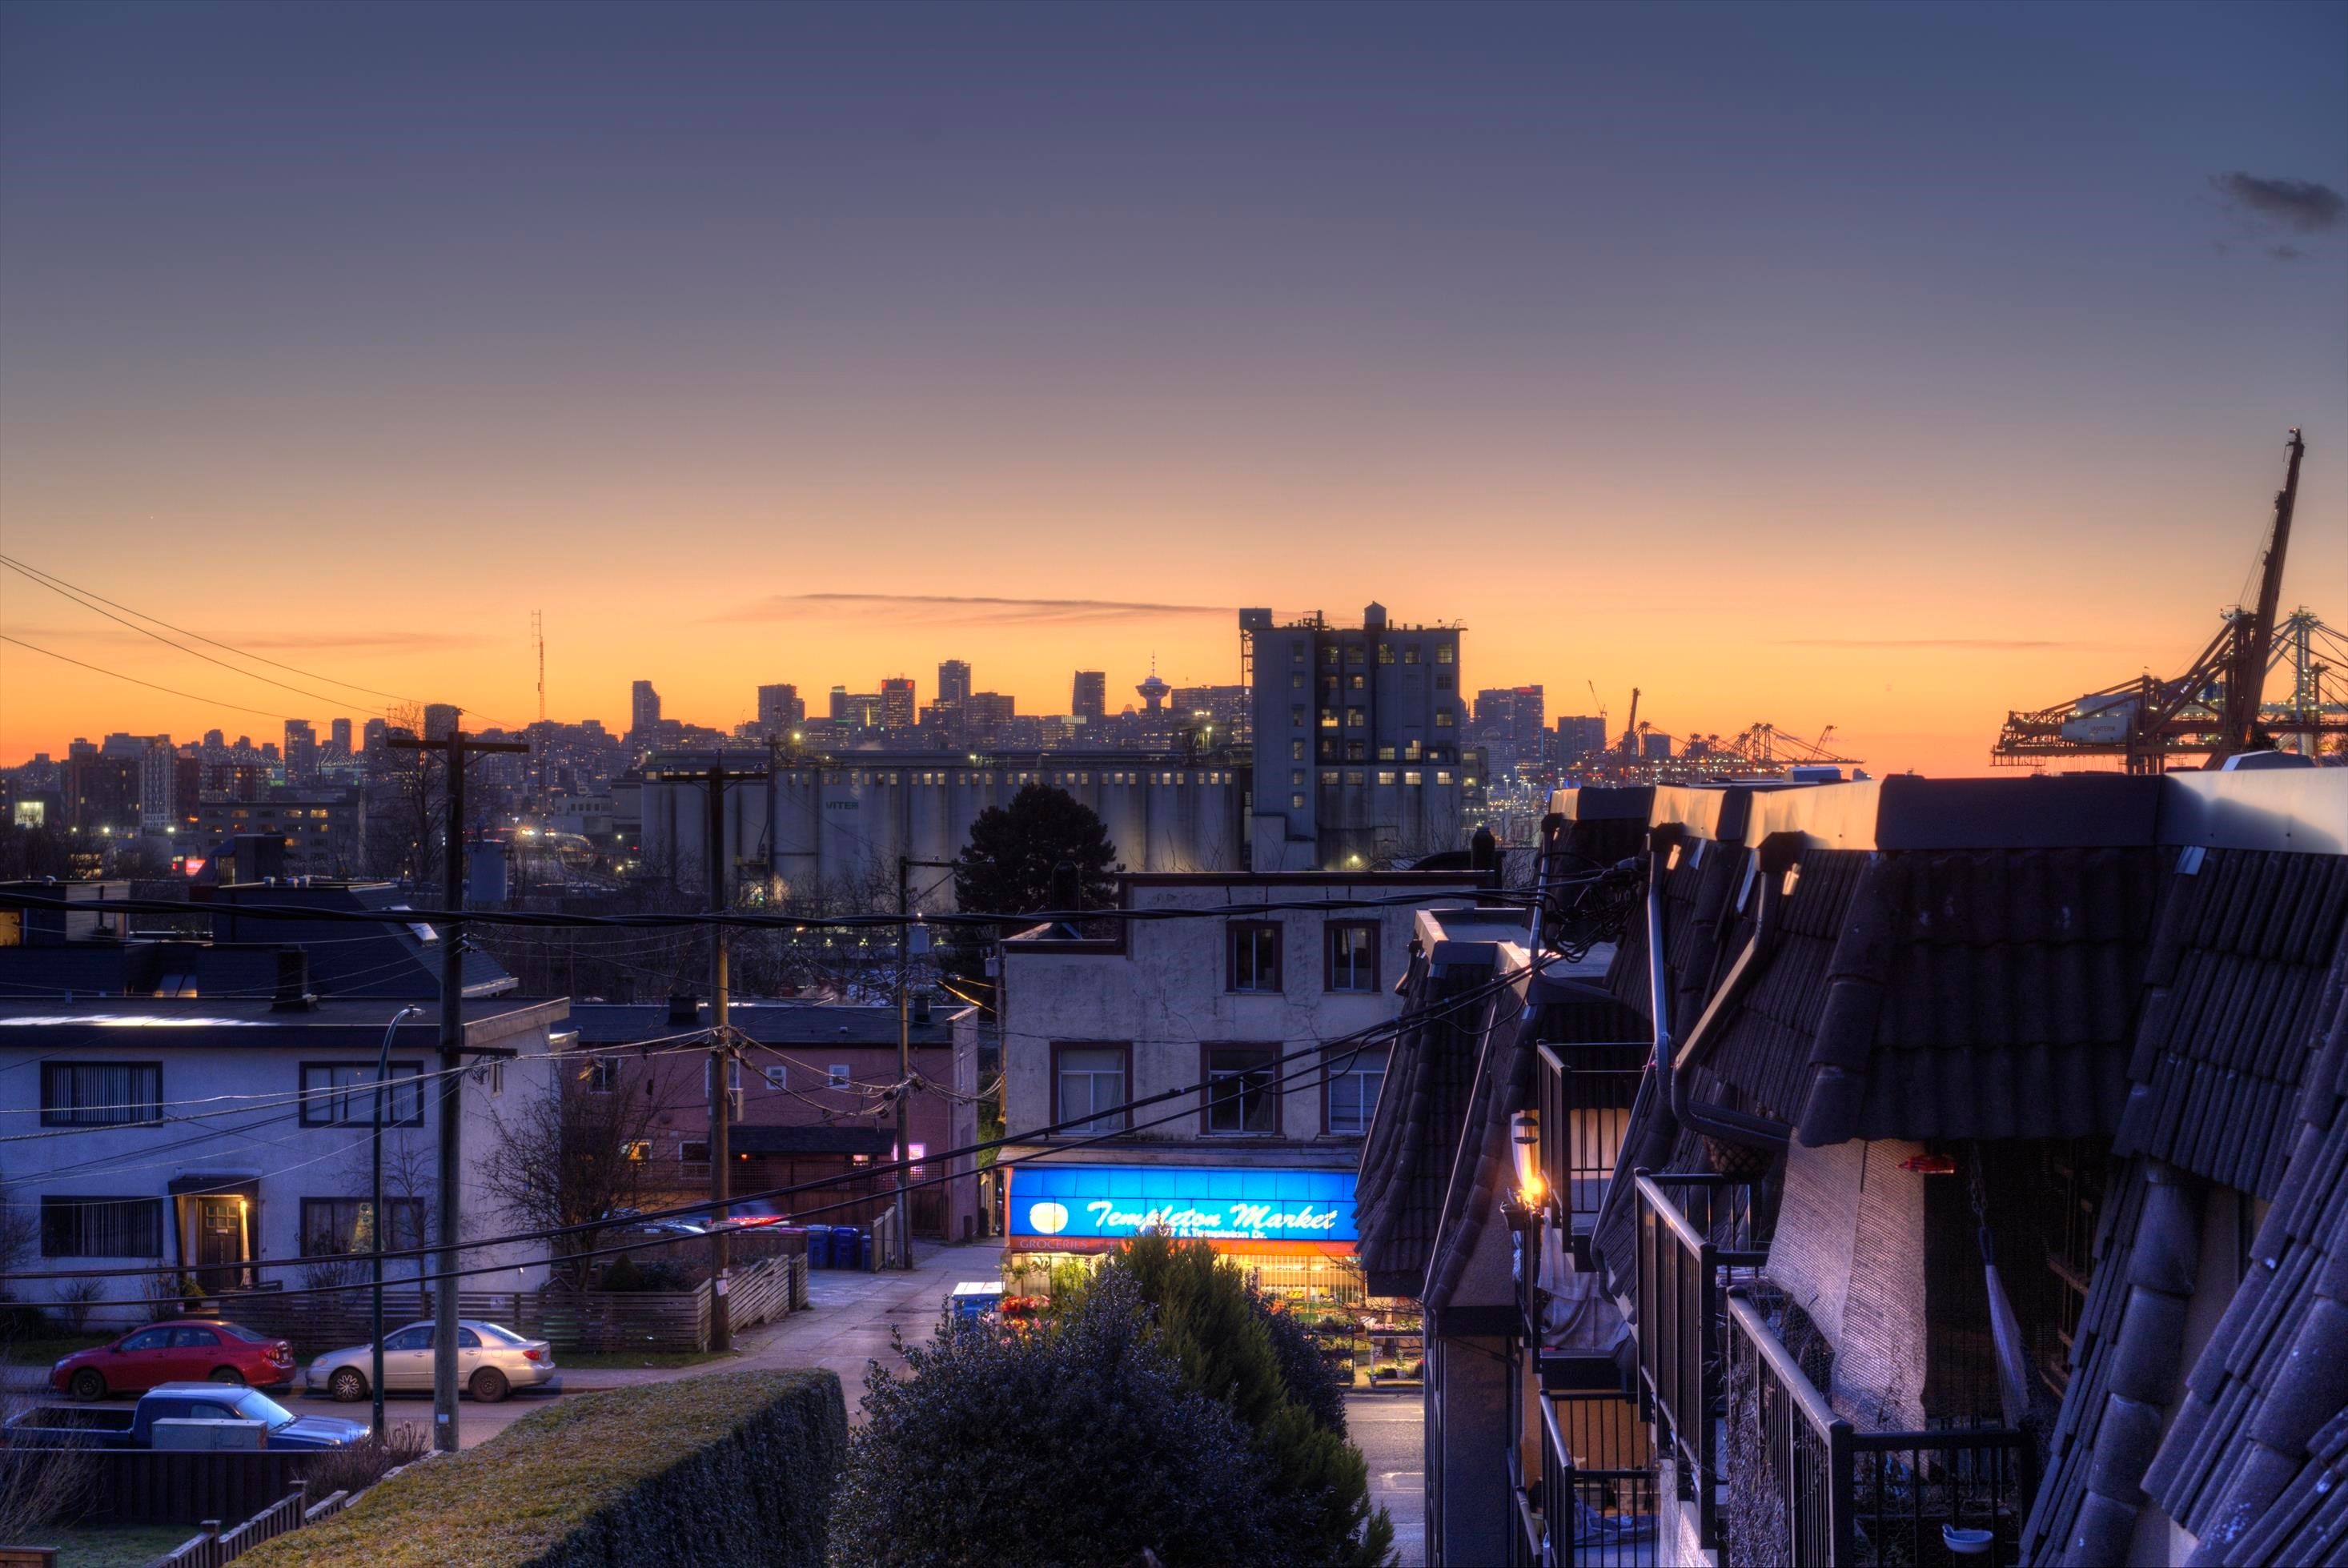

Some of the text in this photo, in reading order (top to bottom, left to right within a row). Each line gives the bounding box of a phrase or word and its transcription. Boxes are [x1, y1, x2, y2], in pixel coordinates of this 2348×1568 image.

[1087, 1201, 1338, 1232] Templeton Market
[1251, 1229, 1268, 1239] Dr.
[1019, 1240, 1089, 1249] GROCERIES
